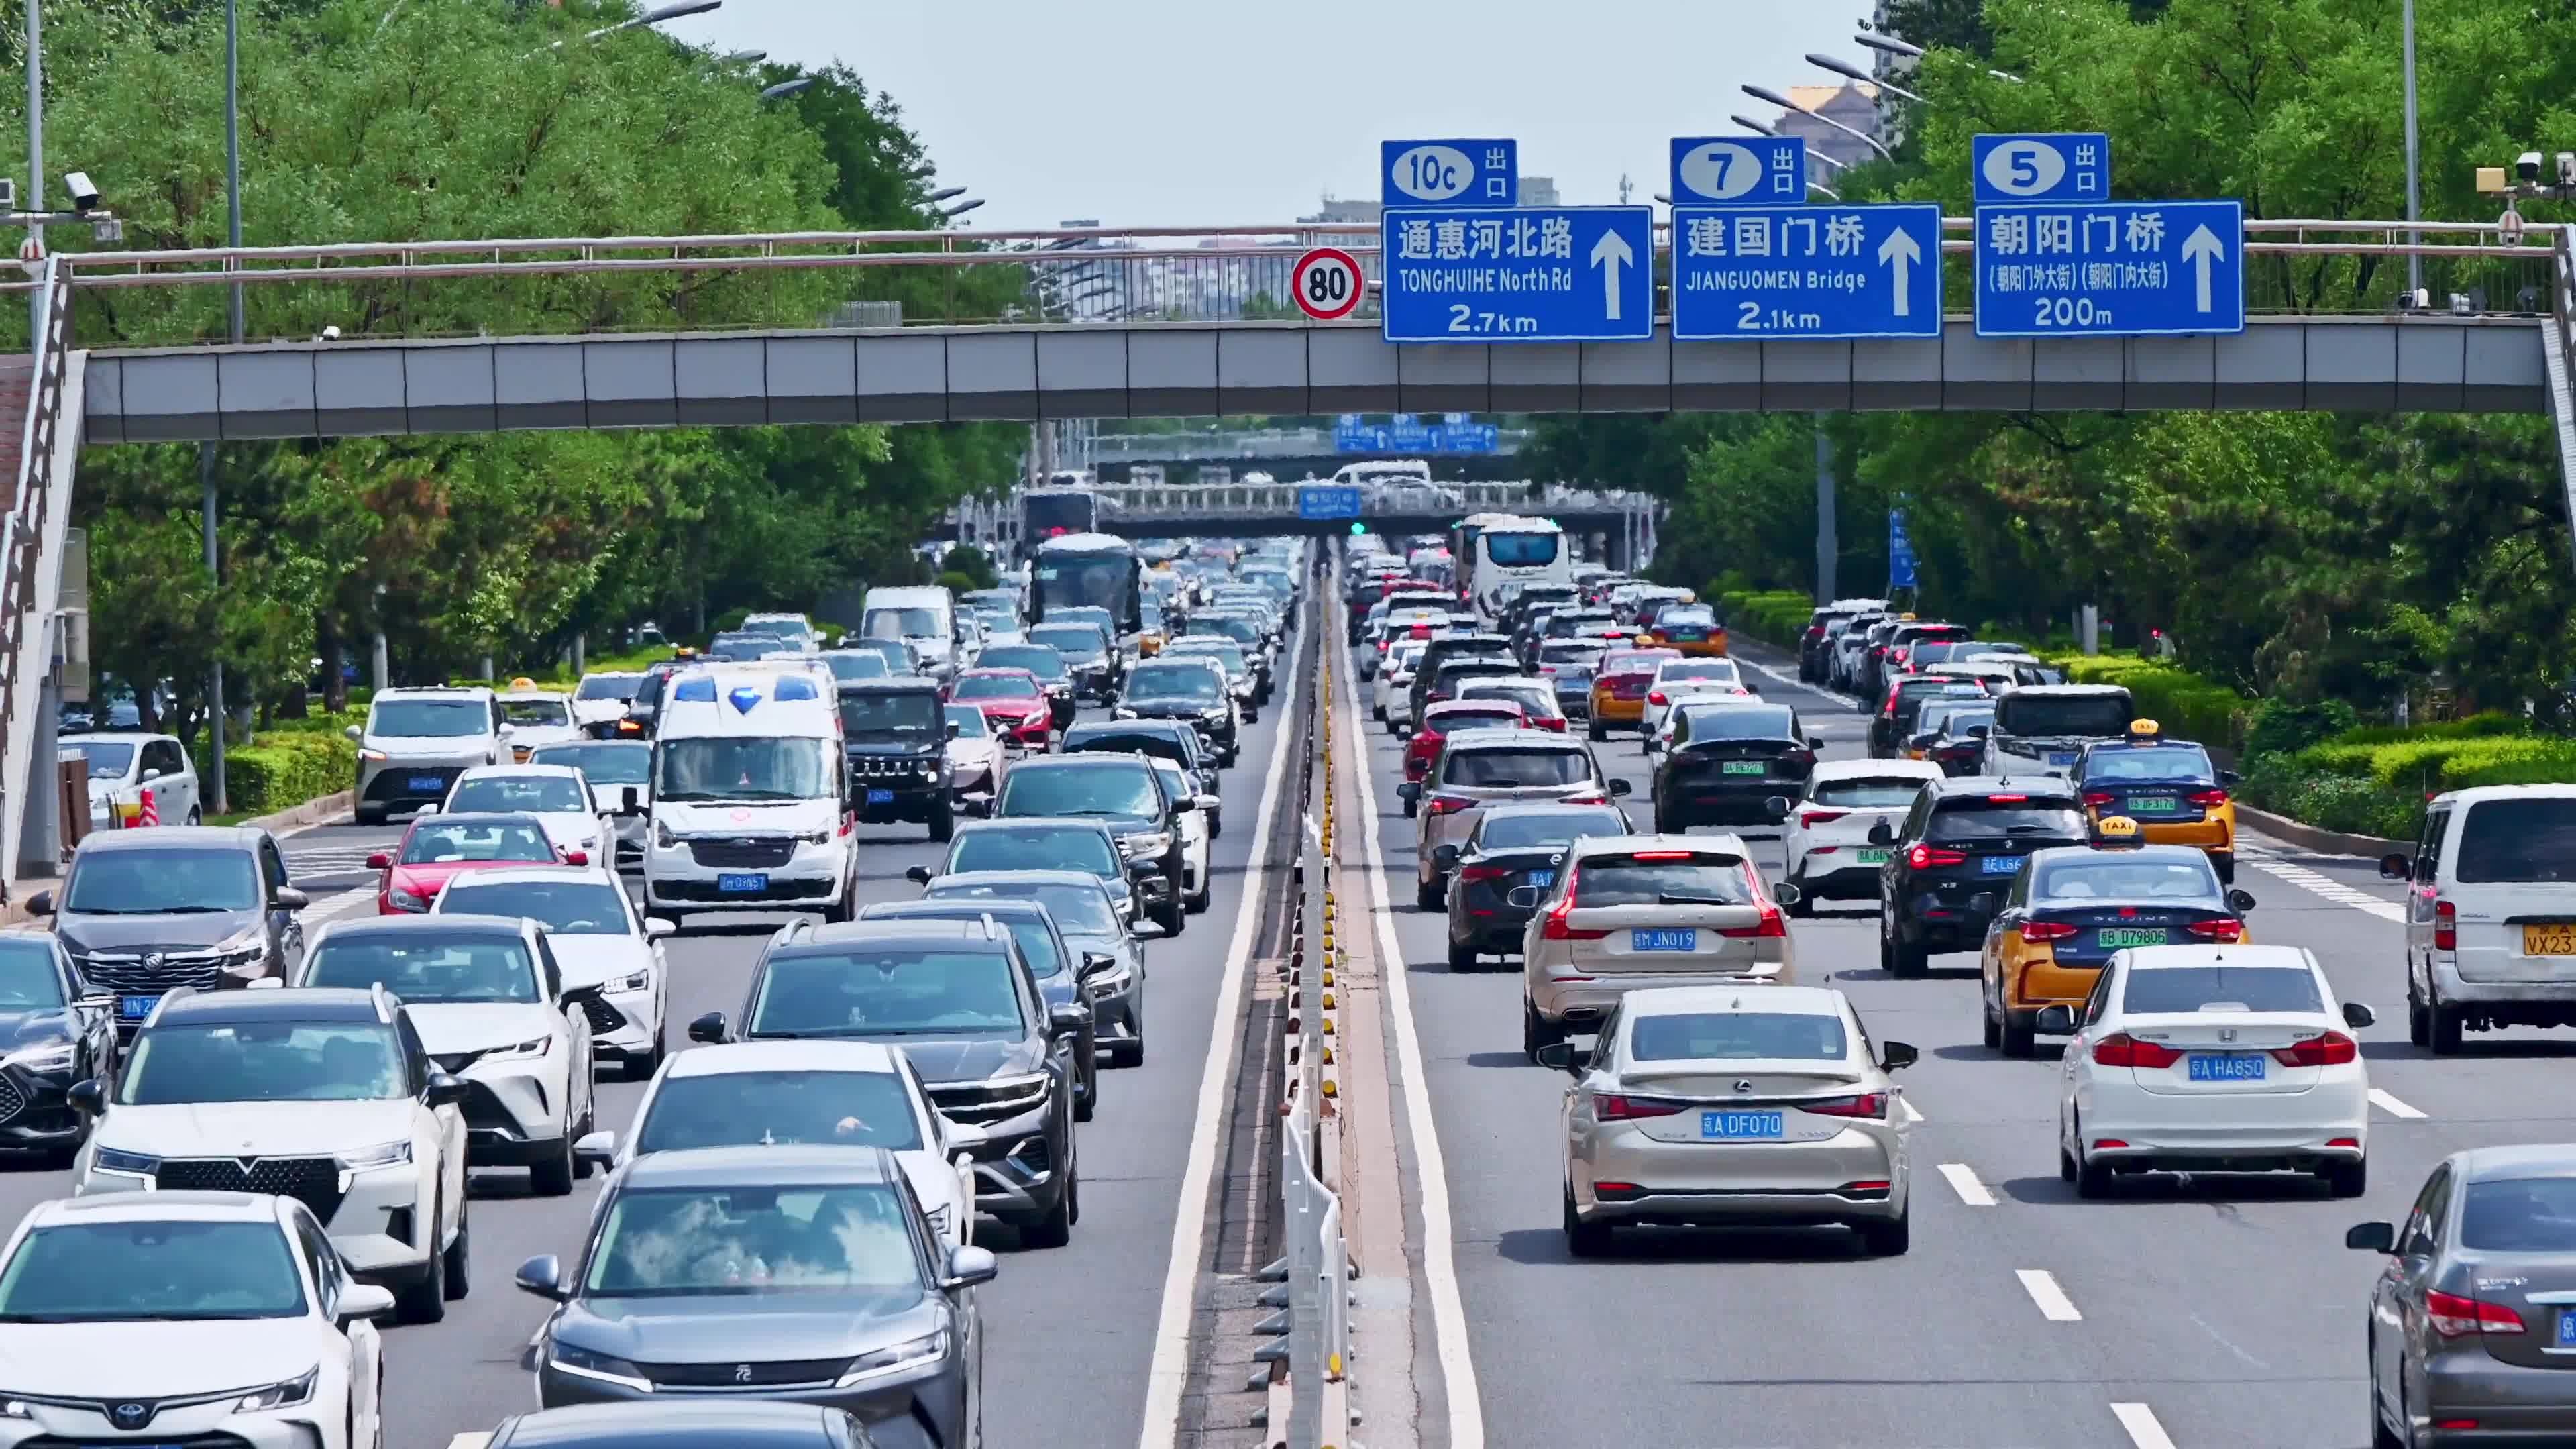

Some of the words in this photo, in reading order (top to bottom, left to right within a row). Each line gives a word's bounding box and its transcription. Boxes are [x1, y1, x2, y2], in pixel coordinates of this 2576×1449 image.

[1410, 154, 1456, 191] 10c
[1485, 148, 1506, 197] 出口
[1707, 152, 1733, 191] 7
[1773, 147, 1794, 194] 出口
[2011, 151, 2039, 188] 5
[2076, 144, 2096, 191] 出口
[1398, 216, 1573, 260] 通惠河北路
[1687, 215, 1865, 257] 建国门桥
[1989, 211, 2165, 255] 朝阳门桥
[1309, 267, 1346, 303] 80
[1400, 268, 1495, 292] TONGHUIHE
[1500, 268, 1548, 291] North
[1552, 267, 1571, 290] Rd
[1686, 270, 1799, 290] JIANGUOMEN
[1807, 270, 1866, 293] Bridge
[1448, 304, 1538, 333] 2.7km
[1737, 301, 1820, 329] 2.1km
[2035, 297, 2112, 326] 200m
[2106, 822, 2131, 830] TAXI
